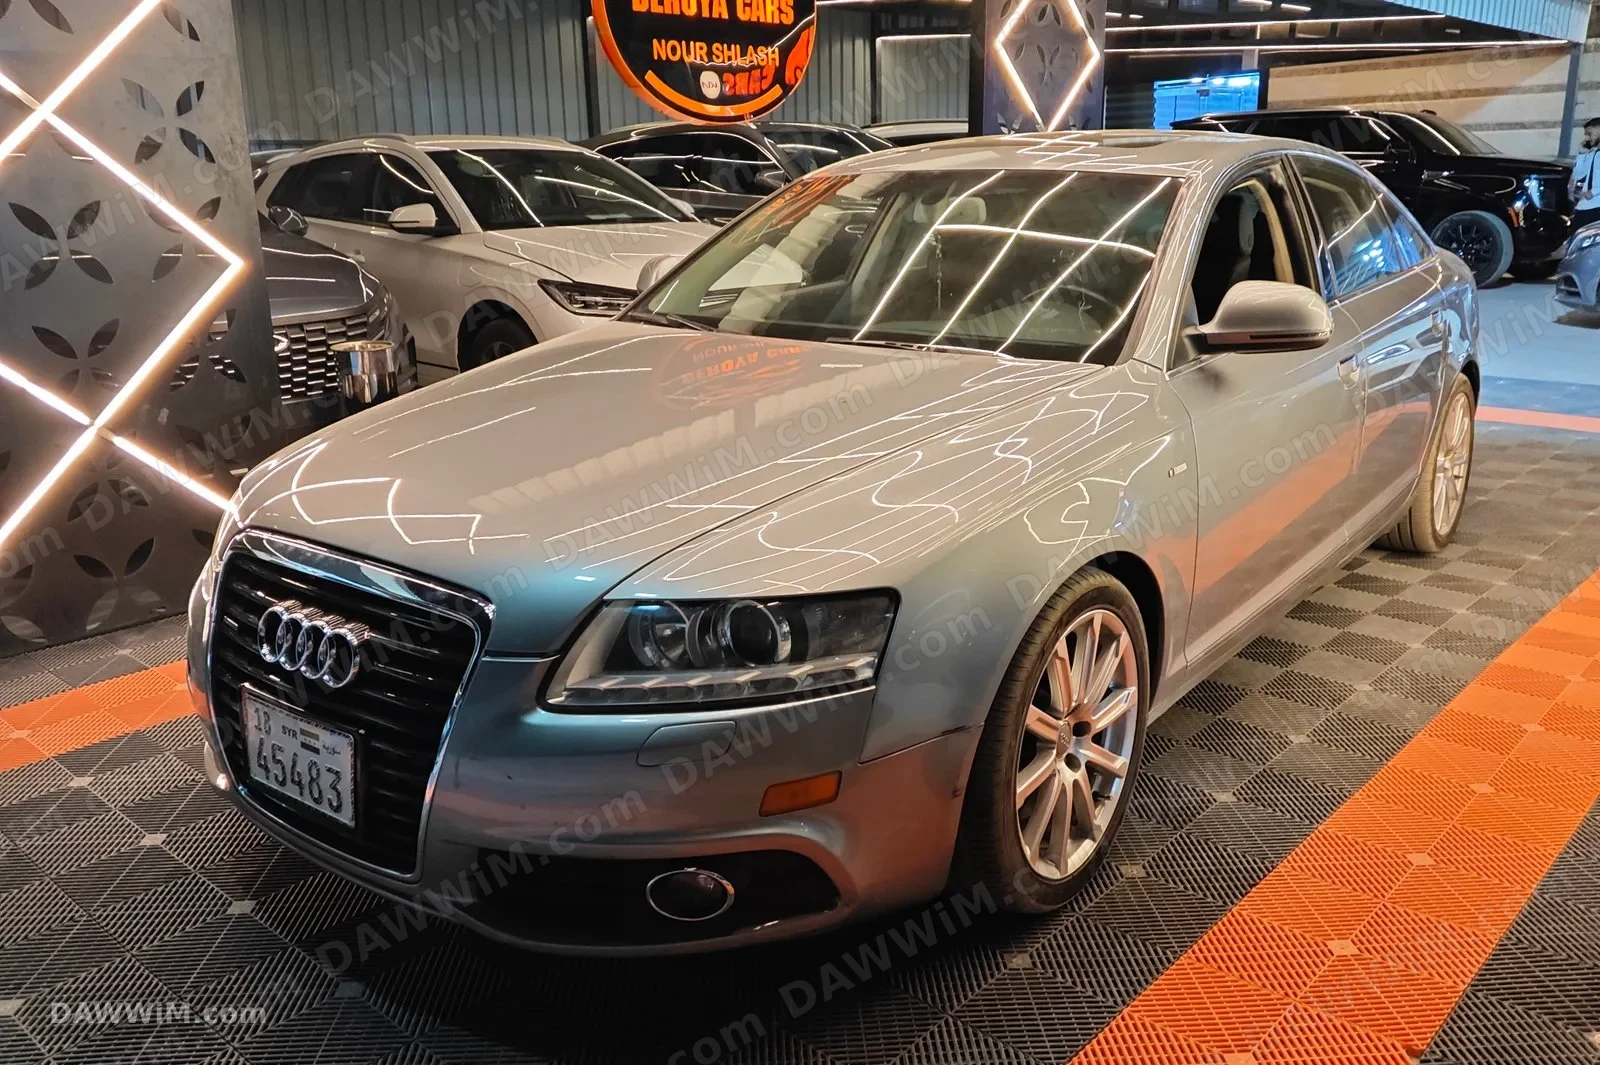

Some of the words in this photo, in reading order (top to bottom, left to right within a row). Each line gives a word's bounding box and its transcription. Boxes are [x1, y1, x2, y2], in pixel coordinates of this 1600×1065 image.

[736, 0, 796, 25] CARS
[652, 38, 709, 63] NOUR
[281, 724, 298, 740] SYR
[256, 737, 342, 813] 45483
